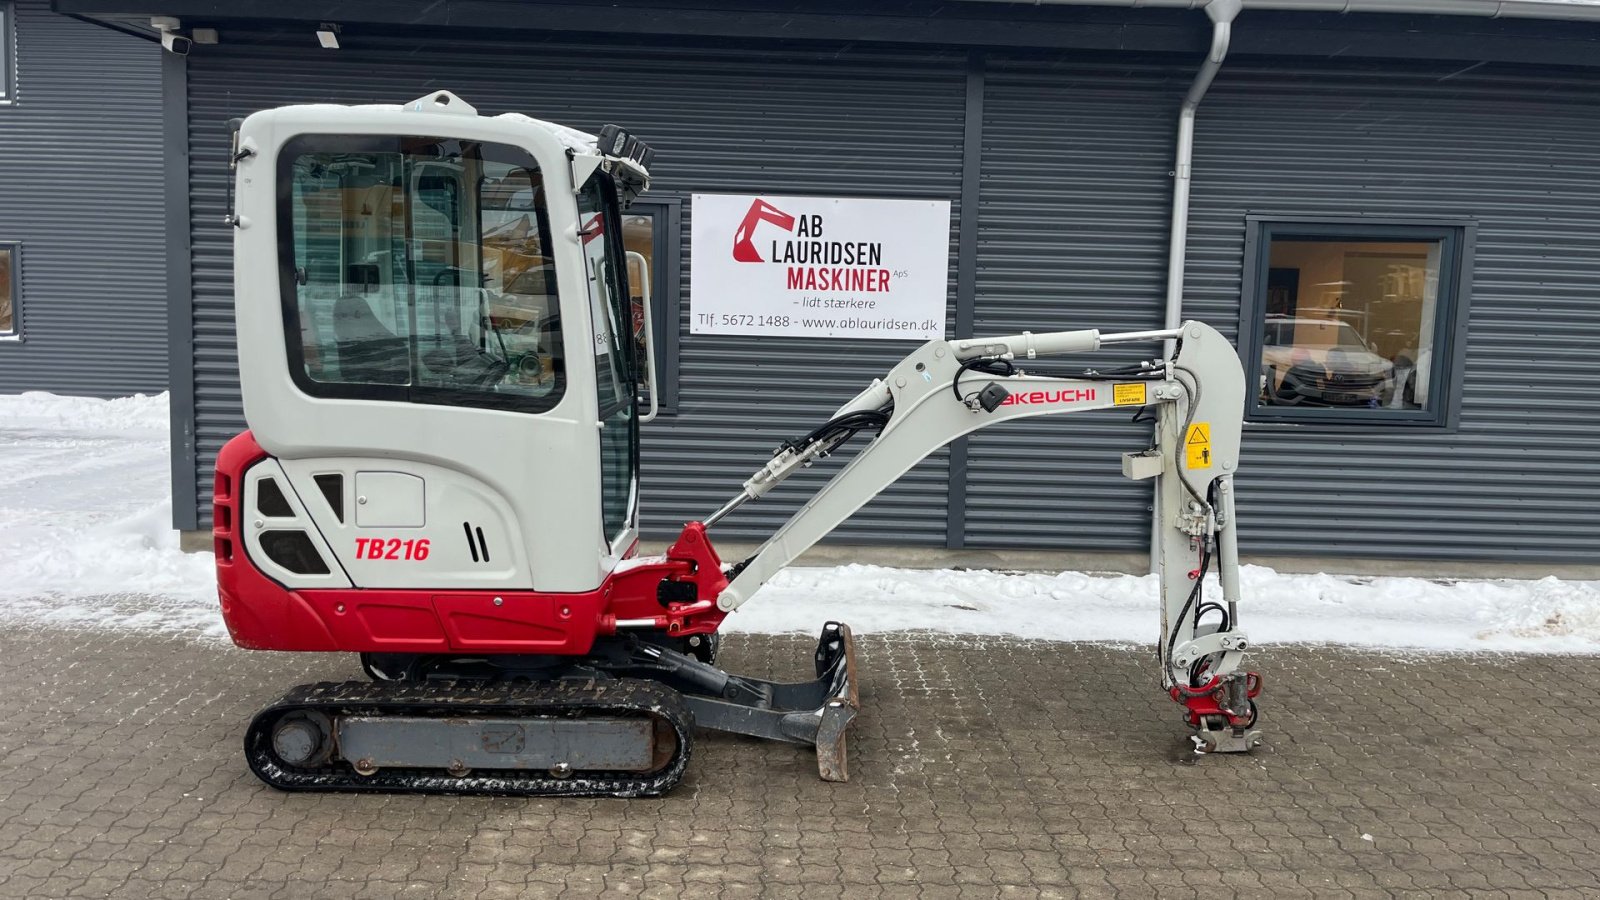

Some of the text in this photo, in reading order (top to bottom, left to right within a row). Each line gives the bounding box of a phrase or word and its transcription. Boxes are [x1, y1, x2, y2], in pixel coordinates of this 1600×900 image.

[797, 214, 823, 238] AB
[772, 240, 881, 265] LAURIDSEN
[787, 267, 908, 292] MASKINER ApS
[802, 297, 821, 308] lidt
[824, 297, 876, 309] stærkere
[698, 313, 718, 328] Tlf.
[723, 314, 754, 326] 5672
[758, 315, 790, 327] 1488
[802, 317, 938, 331] www.ablauridsen.dk
[355, 537, 431, 561] TB216
